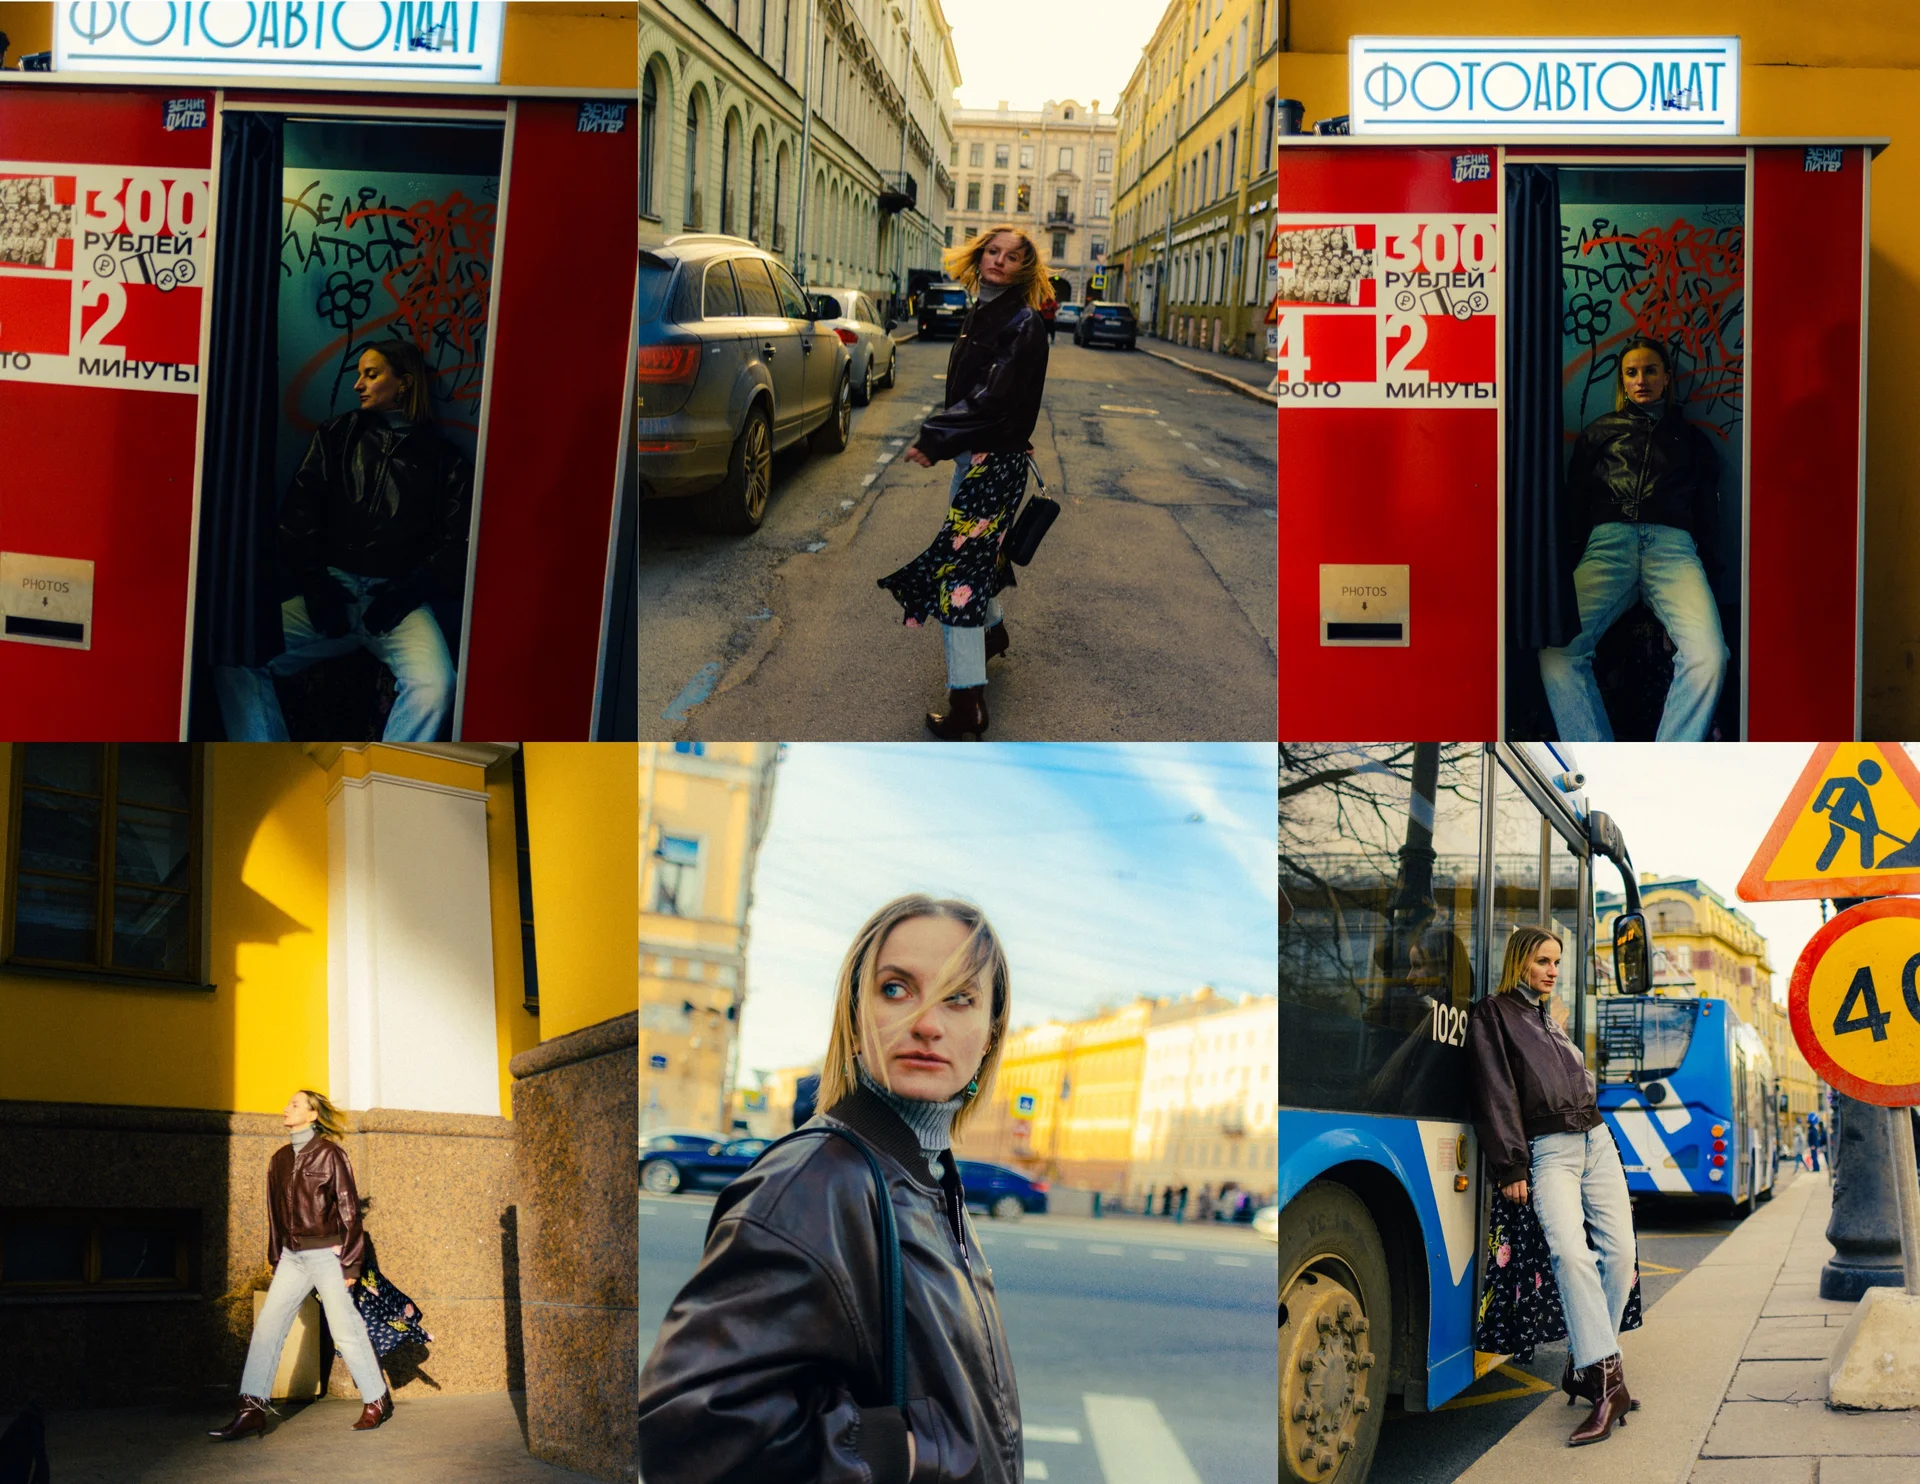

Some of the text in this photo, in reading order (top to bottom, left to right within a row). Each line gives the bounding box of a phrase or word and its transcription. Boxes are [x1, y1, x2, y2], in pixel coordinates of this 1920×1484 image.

[1364, 61, 1726, 112] ФОТОАВТОМАТ
[83, 177, 208, 238] 300
[83, 231, 193, 255] РУБЛЕЙ
[1386, 224, 1496, 273] 300
[1385, 267, 1484, 288] РУБЛЕЙ
[80, 280, 127, 358] 2
[79, 357, 198, 383] МИНУТЫ
[1279, 314, 1311, 382] 4
[1386, 314, 1429, 382] 2
[1386, 382, 1496, 399] МИНУТЫ
[22, 578, 69, 593] PHOTOS
[1342, 586, 1387, 597] PHOTOS
[1432, 999, 1468, 1047] 1029
